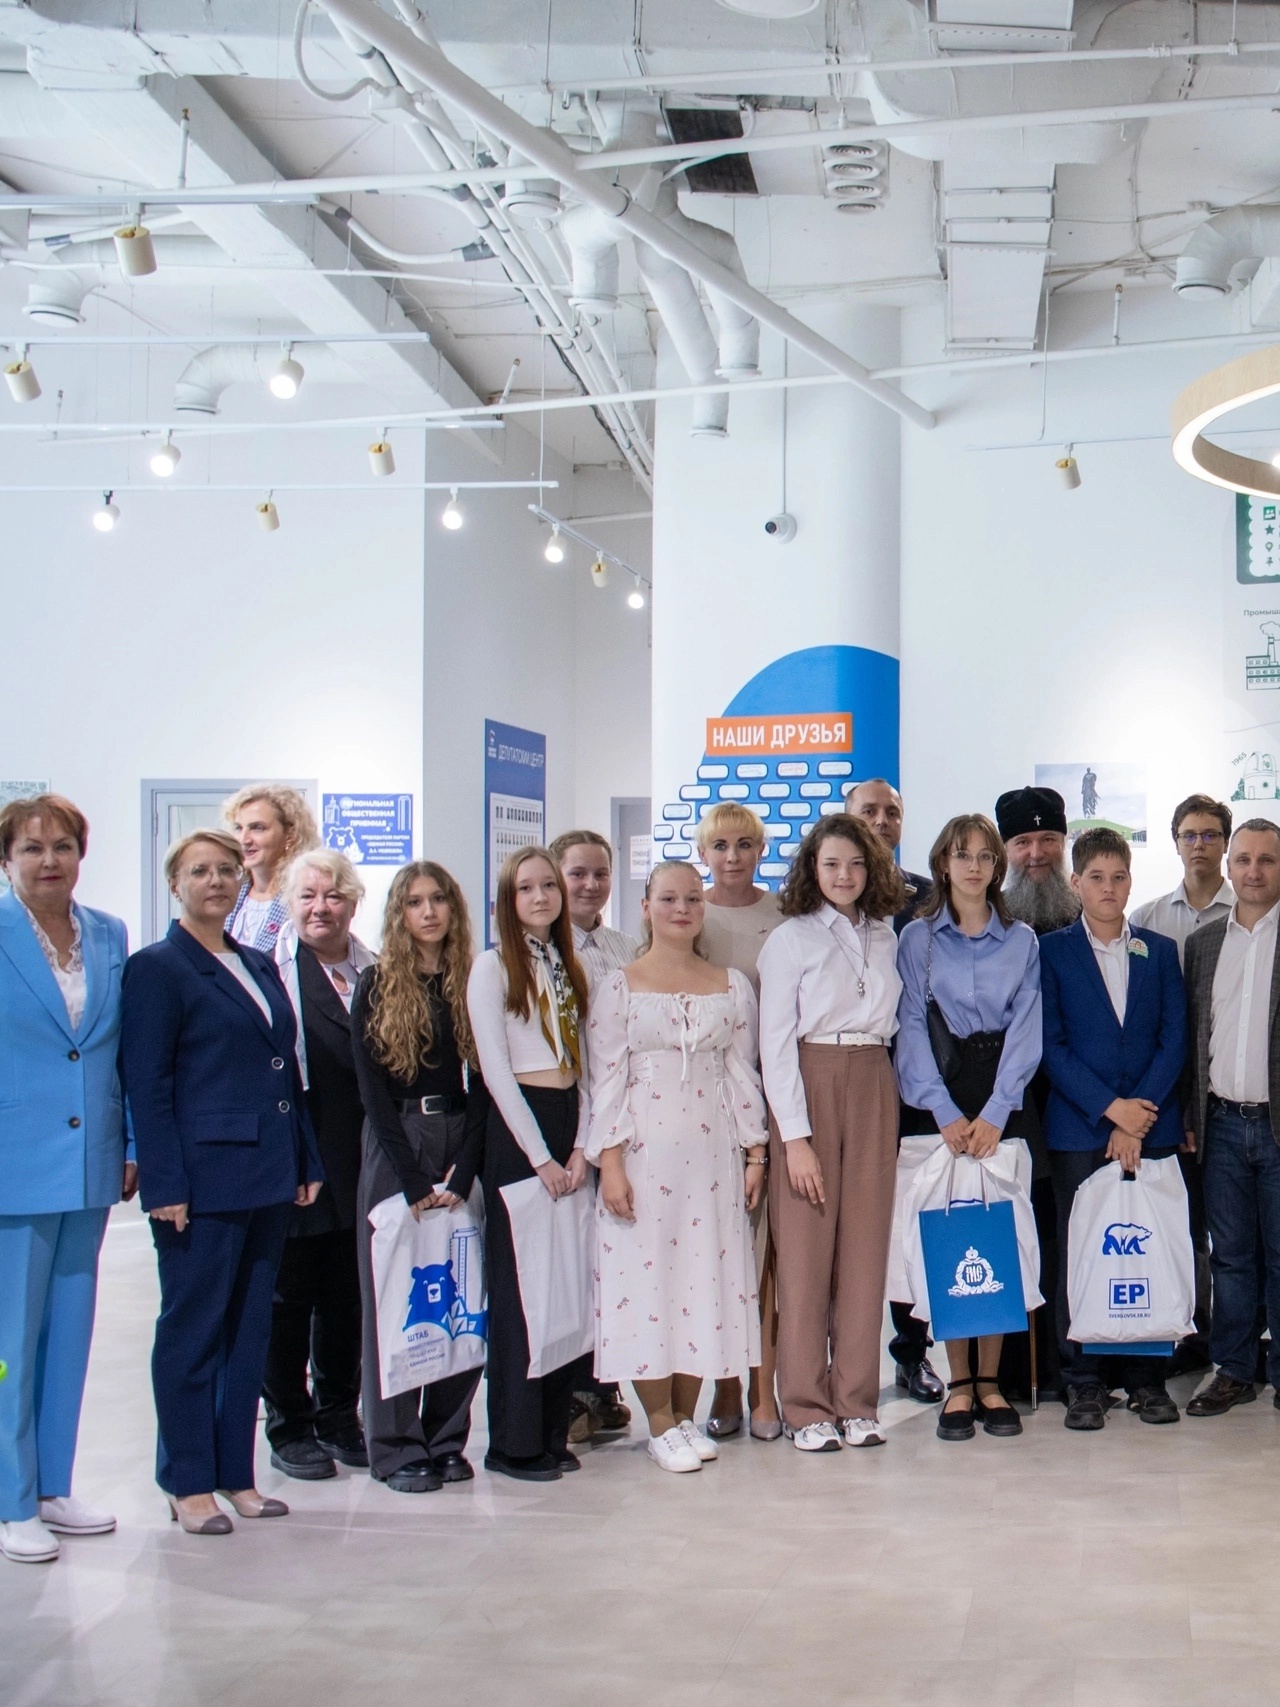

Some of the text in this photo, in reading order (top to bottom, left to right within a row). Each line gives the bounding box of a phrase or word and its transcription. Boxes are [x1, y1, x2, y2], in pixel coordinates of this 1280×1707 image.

[713, 722, 846, 749] НАШИ ДРУЗЬЯ
[1231, 751, 1246, 766] 1965
[408, 1330, 429, 1342] ШТАБ
